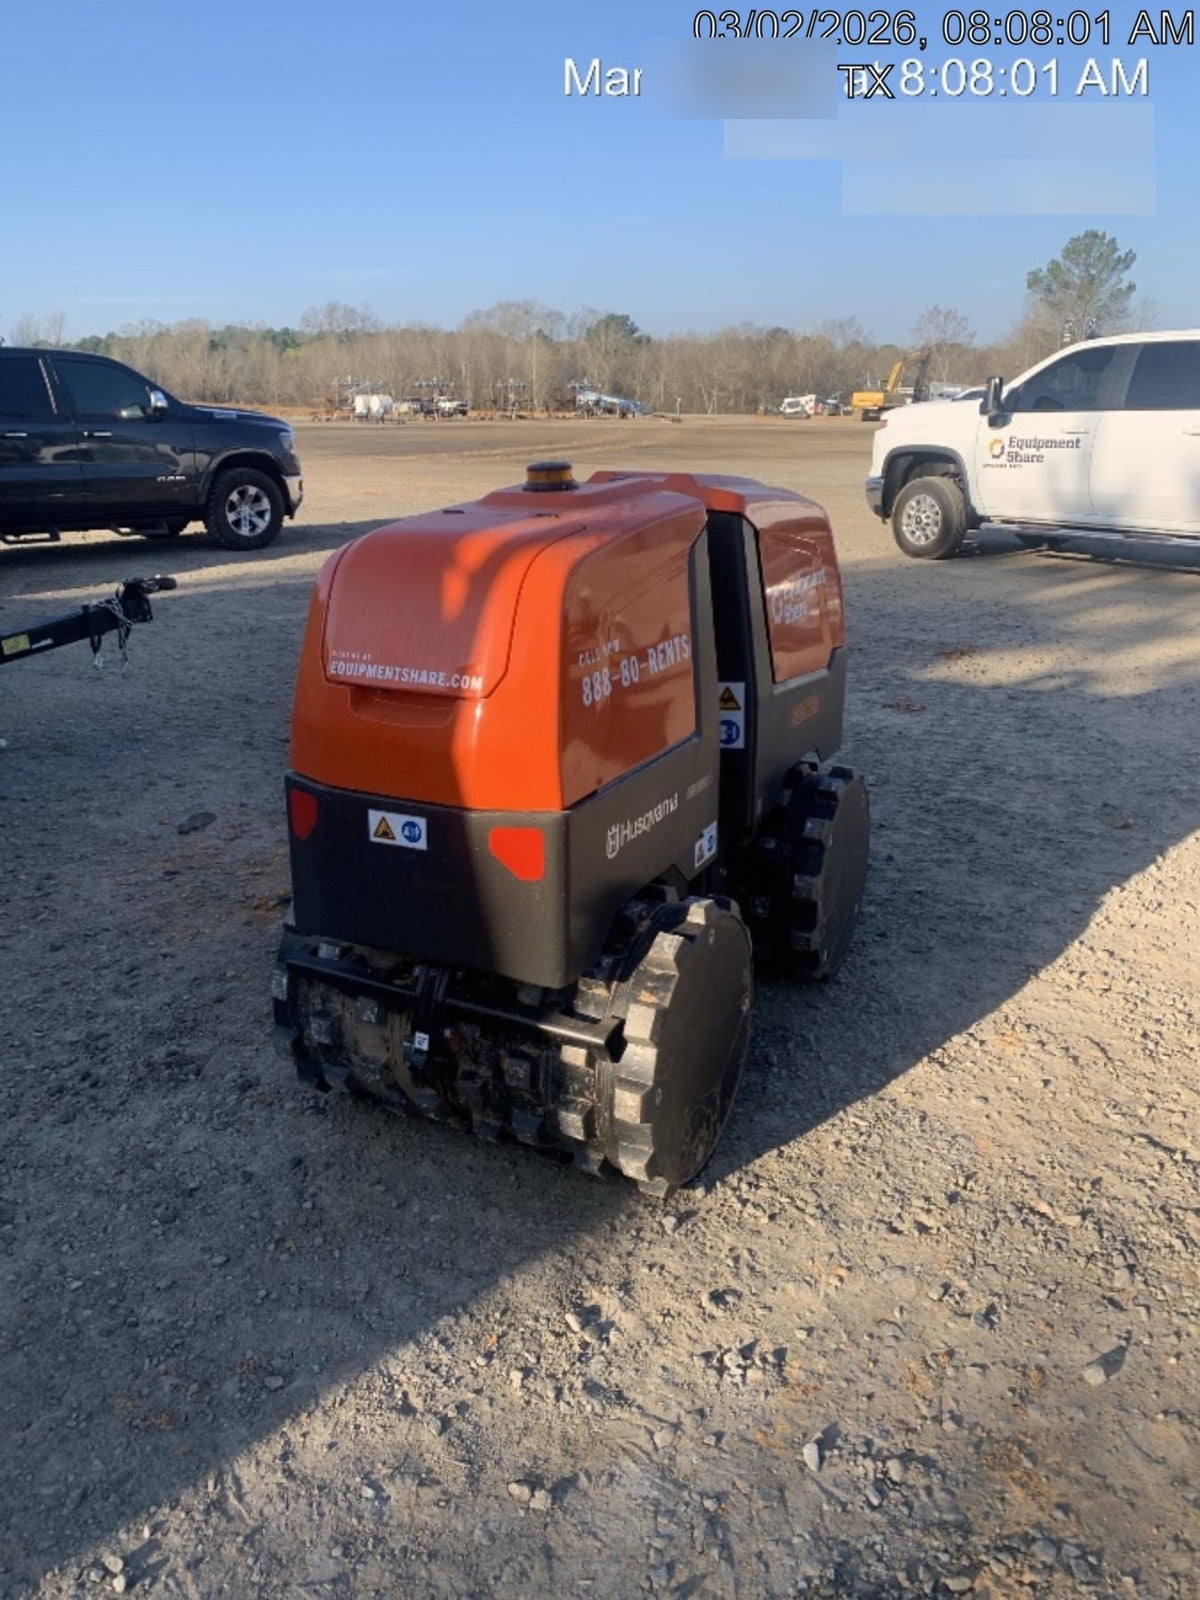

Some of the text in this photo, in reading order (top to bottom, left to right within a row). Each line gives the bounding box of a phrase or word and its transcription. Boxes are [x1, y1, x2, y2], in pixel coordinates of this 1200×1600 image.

[1008, 436, 1081, 450] Equipment
[1007, 451, 1044, 462] Share
[329, 660, 484, 692] EQUIPMENTSHARE.COM
[582, 634, 689, 706] 888-80-RENTS
